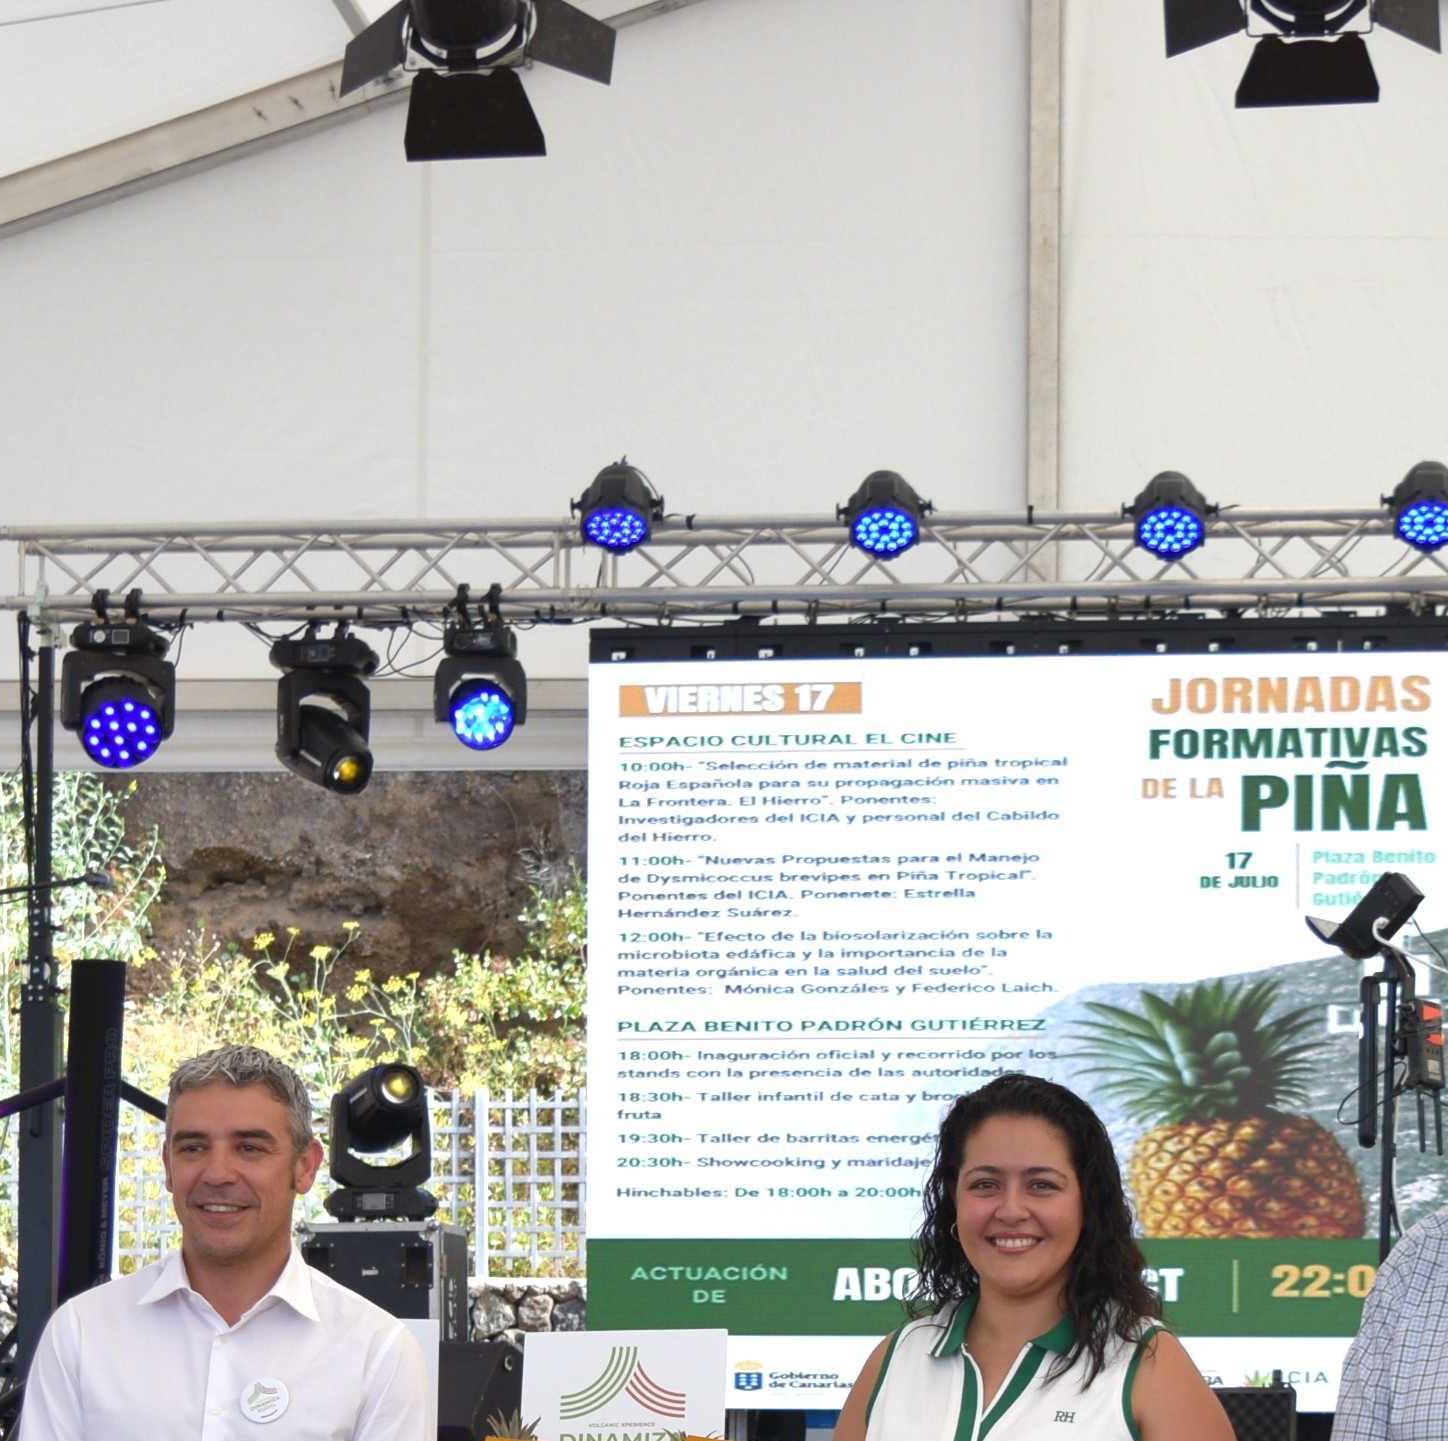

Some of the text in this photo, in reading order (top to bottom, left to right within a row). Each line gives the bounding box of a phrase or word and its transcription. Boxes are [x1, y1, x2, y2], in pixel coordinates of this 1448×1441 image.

[644, 683, 835, 714] VIERNES 17
[1151, 675, 1432, 715] JORNADAS
[618, 732, 956, 748] ESPACIO CULTURAL EL CINE
[1149, 726, 1429, 760] FORMATIVAS
[804, 759, 828, 769] de
[832, 758, 912, 769] material
[918, 758, 942, 768] de
[947, 757, 988, 770] piña
[994, 756, 1068, 770] tropical
[618, 775, 1059, 792] Roja Española para su propagación masiva en
[618, 797, 640, 807] La
[739, 795, 756, 806] El
[1141, 760, 1428, 832] DE LA PIÑA
[618, 810, 1060, 827] Investigadores del ICIA y personal del Cabildo
[617, 831, 646, 842] del
[781, 853, 891, 867] Propuestas
[897, 855, 939, 866] para
[945, 852, 962, 862] el
[968, 851, 1040, 865] Manejo
[1224, 851, 1253, 870] 17
[1312, 850, 1436, 864] Plaza Benito
[617, 873, 641, 884] de
[646, 872, 773, 886] Dysmicoccus
[779, 871, 861, 884] brevipes
[867, 873, 890, 881] en
[896, 870, 939, 880] Piña
[1199, 874, 1279, 889] DE JULIO
[617, 890, 708, 901] Ponentes
[712, 889, 742, 900] del
[903, 887, 976, 898] Estrella
[1312, 891, 1363, 906] Gutié
[617, 907, 720, 918] Hernández
[771, 930, 794, 942] de
[800, 930, 817, 941] la
[822, 929, 969, 941] biosolarización
[975, 929, 1030, 940] sobre
[1035, 928, 1053, 939] la
[617, 946, 1007, 961] microbiota edáfica y la importancia de la
[617, 967, 690, 977] materia
[695, 966, 778, 979] orgánica
[784, 968, 808, 976] en
[813, 965, 830, 976] la
[836, 965, 887, 976] salud
[893, 965, 922, 975] del
[724, 983, 794, 994] Mónica
[895, 985, 906, 995] y
[911, 981, 995, 993] Federico
[617, 1016, 1048, 1032] PLAZA BENITO PADRÓN GUTIÉRREZ
[815, 1049, 875, 1060] oficial
[881, 1052, 892, 1062] y
[896, 1049, 986, 1060] recorrido
[990, 1050, 1024, 1061] por
[1027, 1048, 1057, 1060] los
[617, 1067, 680, 1078] stands
[685, 1070, 721, 1078] con
[726, 1067, 743, 1078] la
[748, 1067, 842, 1080] presencia
[848, 1067, 872, 1077] de
[877, 1066, 905, 1077] las
[696, 1091, 752, 1102] Taller
[757, 1090, 824, 1102] infantil
[829, 1090, 853, 1101] de
[858, 1092, 900, 1101] cata
[904, 1093, 917, 1104] y
[616, 1109, 662, 1120] fruta
[696, 1133, 751, 1143] Taller
[756, 1132, 780, 1143] de
[786, 1132, 860, 1144] barritas
[696, 1155, 825, 1170] Showcooking
[831, 1159, 842, 1169] y
[616, 1186, 728, 1198] Hinchables:
[734, 1186, 760, 1198] De
[767, 1186, 832, 1198] 18:00h
[837, 1189, 849, 1197] a
[630, 1263, 789, 1281] ACTUACIÓN
[1271, 1264, 1376, 1298] 22:0
[692, 1289, 726, 1303] DE
[768, 1371, 840, 1380] Gobierno
[768, 1380, 854, 1389] de Canarias
